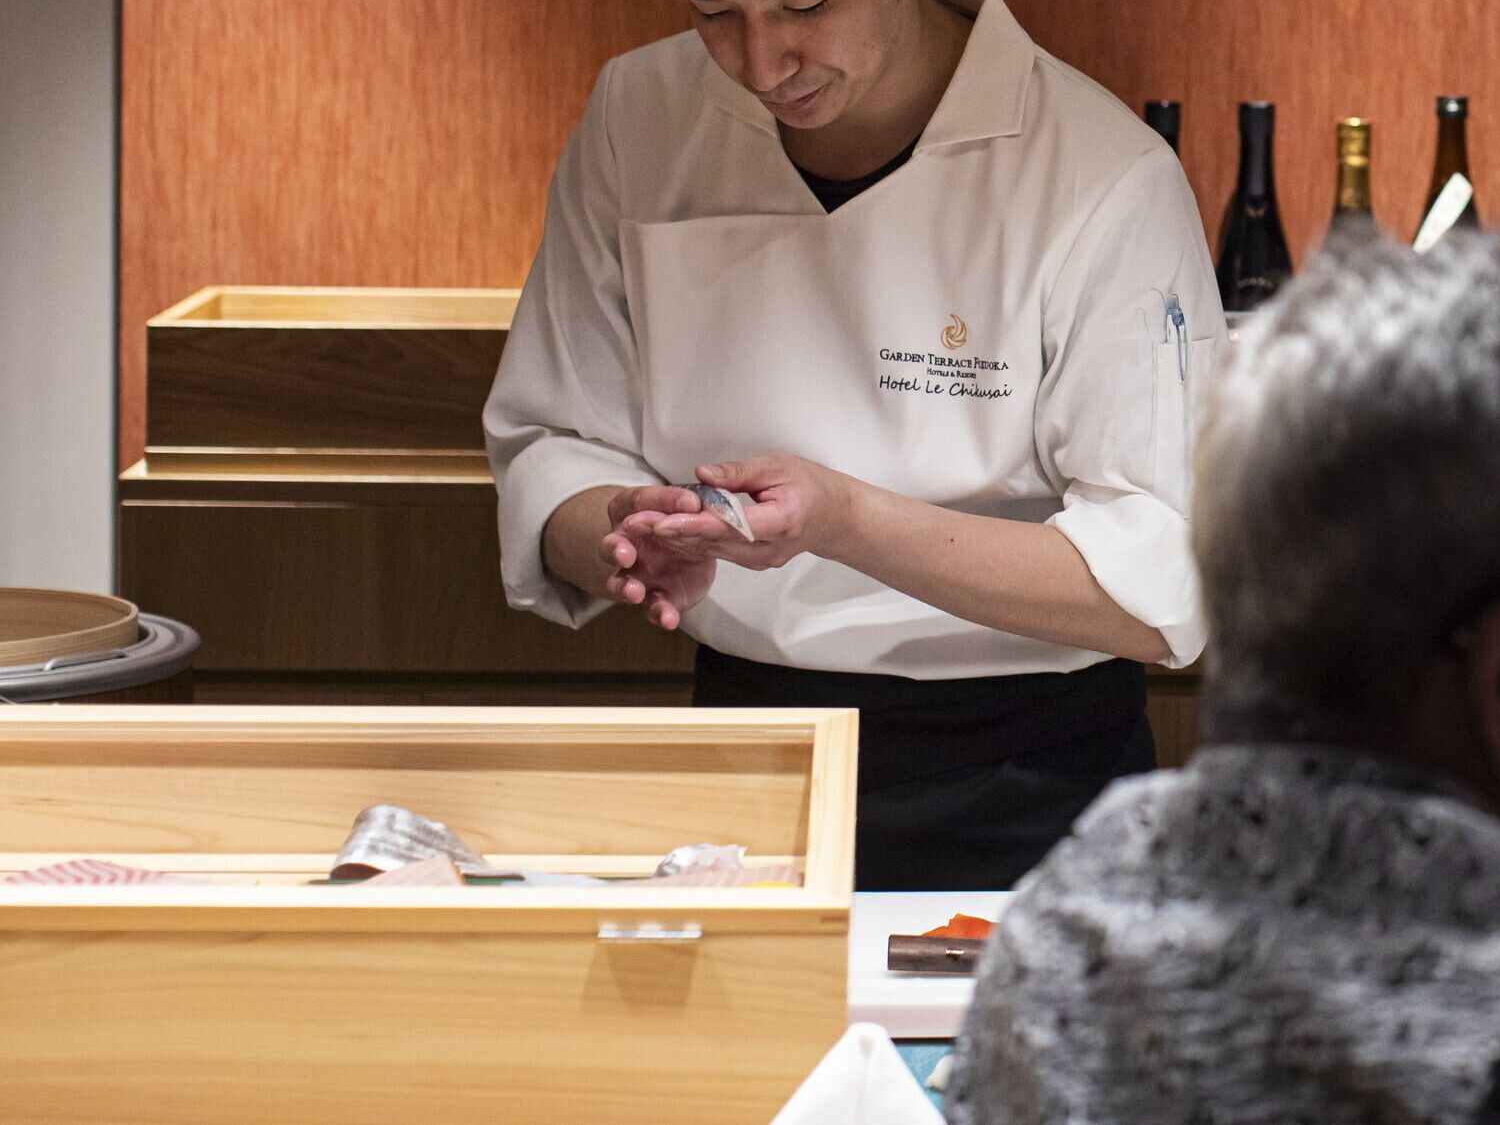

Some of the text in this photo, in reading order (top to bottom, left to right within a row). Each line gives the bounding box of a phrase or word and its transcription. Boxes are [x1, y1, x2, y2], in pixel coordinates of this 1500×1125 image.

[879, 348, 925, 363] GARDEN
[927, 353, 972, 368] TERRACE
[879, 375, 1012, 399] Hotel Le Chikusai
